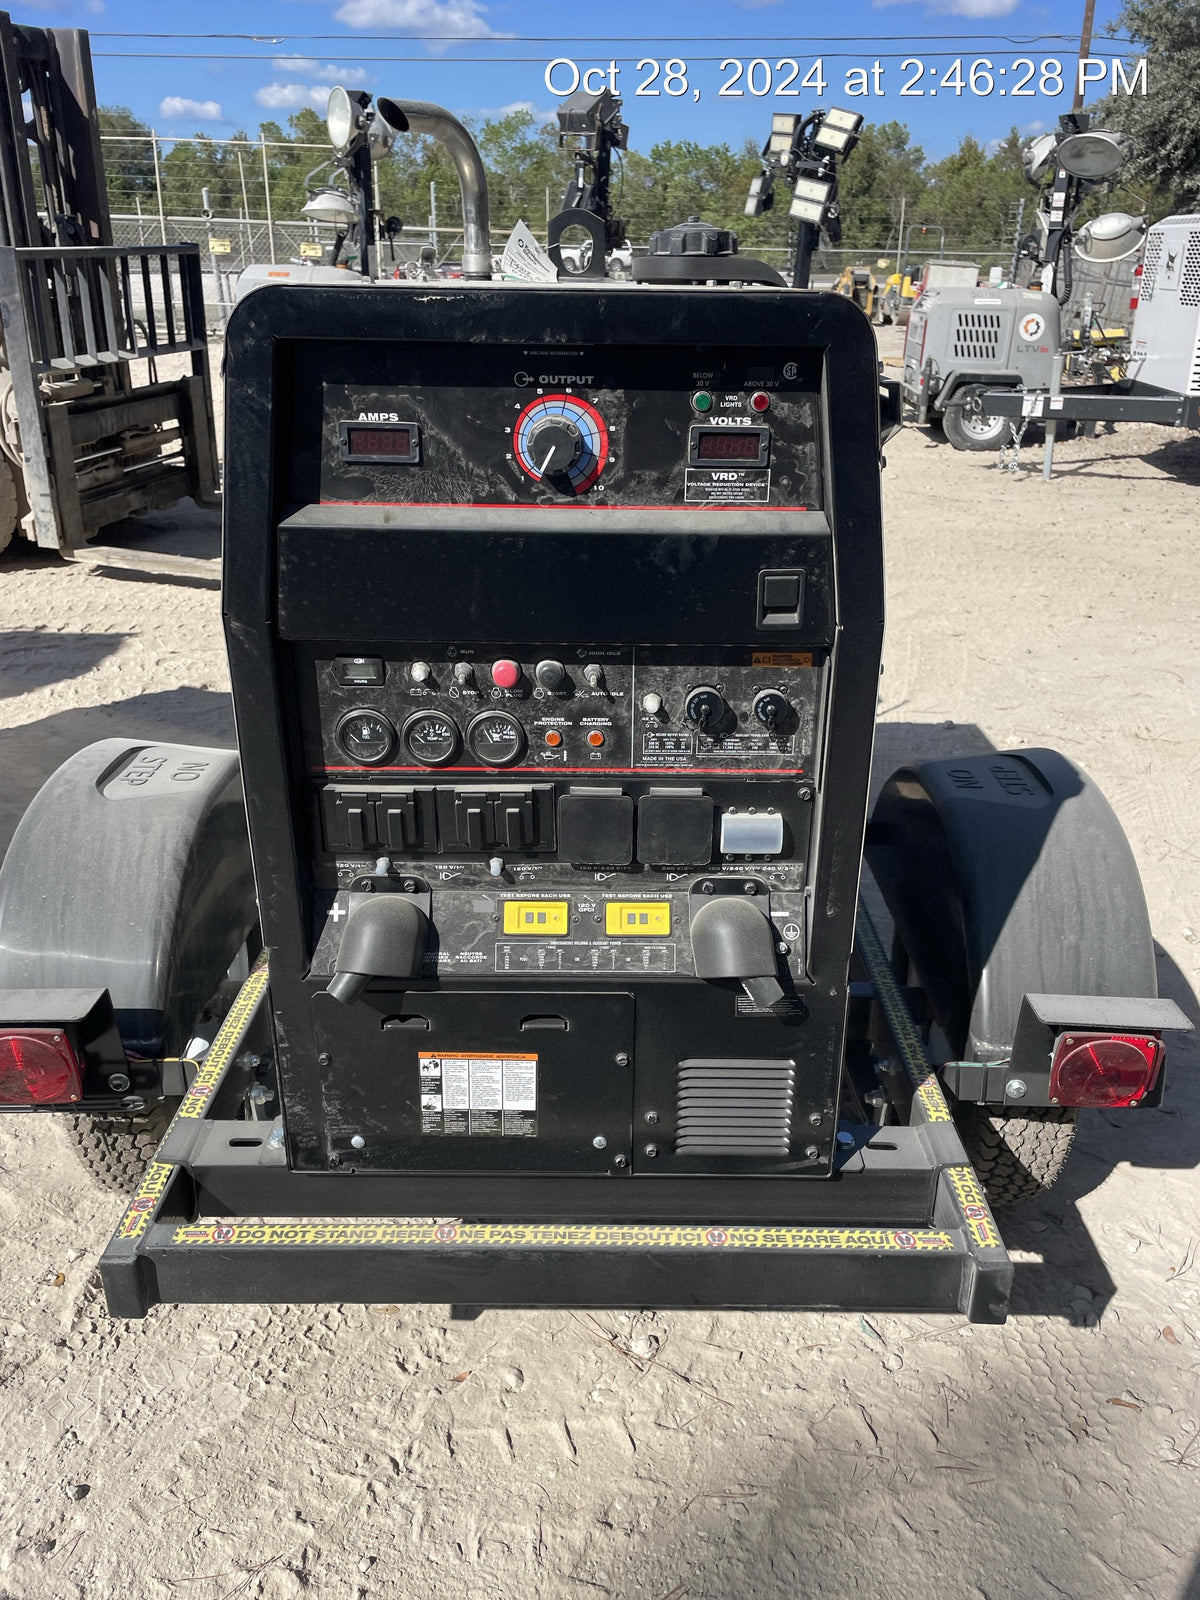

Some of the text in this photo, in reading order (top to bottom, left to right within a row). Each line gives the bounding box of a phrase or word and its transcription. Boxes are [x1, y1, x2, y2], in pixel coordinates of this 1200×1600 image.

[538, 375, 594, 384] OUTPUT
[358, 412, 399, 421] AMPS
[710, 417, 752, 425] VOLTS
[120, 756, 168, 786] STEP
[170, 762, 210, 782] NO
[947, 770, 984, 790] NO
[988, 766, 1036, 796] STEP
[200, 974, 263, 1083] NE PAS TENEZ DEBOUT ICI
[185, 1098, 201, 1114] NO
[924, 1089, 943, 1112] HERE
[961, 1184, 976, 1204] DO
[237, 1229, 432, 1239] DO NOT STAND HERE
[459, 1230, 702, 1242] NE PAS TENEZ DEBOUT ICI
[730, 1233, 760, 1243] NO
[764, 1234, 788, 1244] SE
[792, 1234, 842, 1244] PARE
